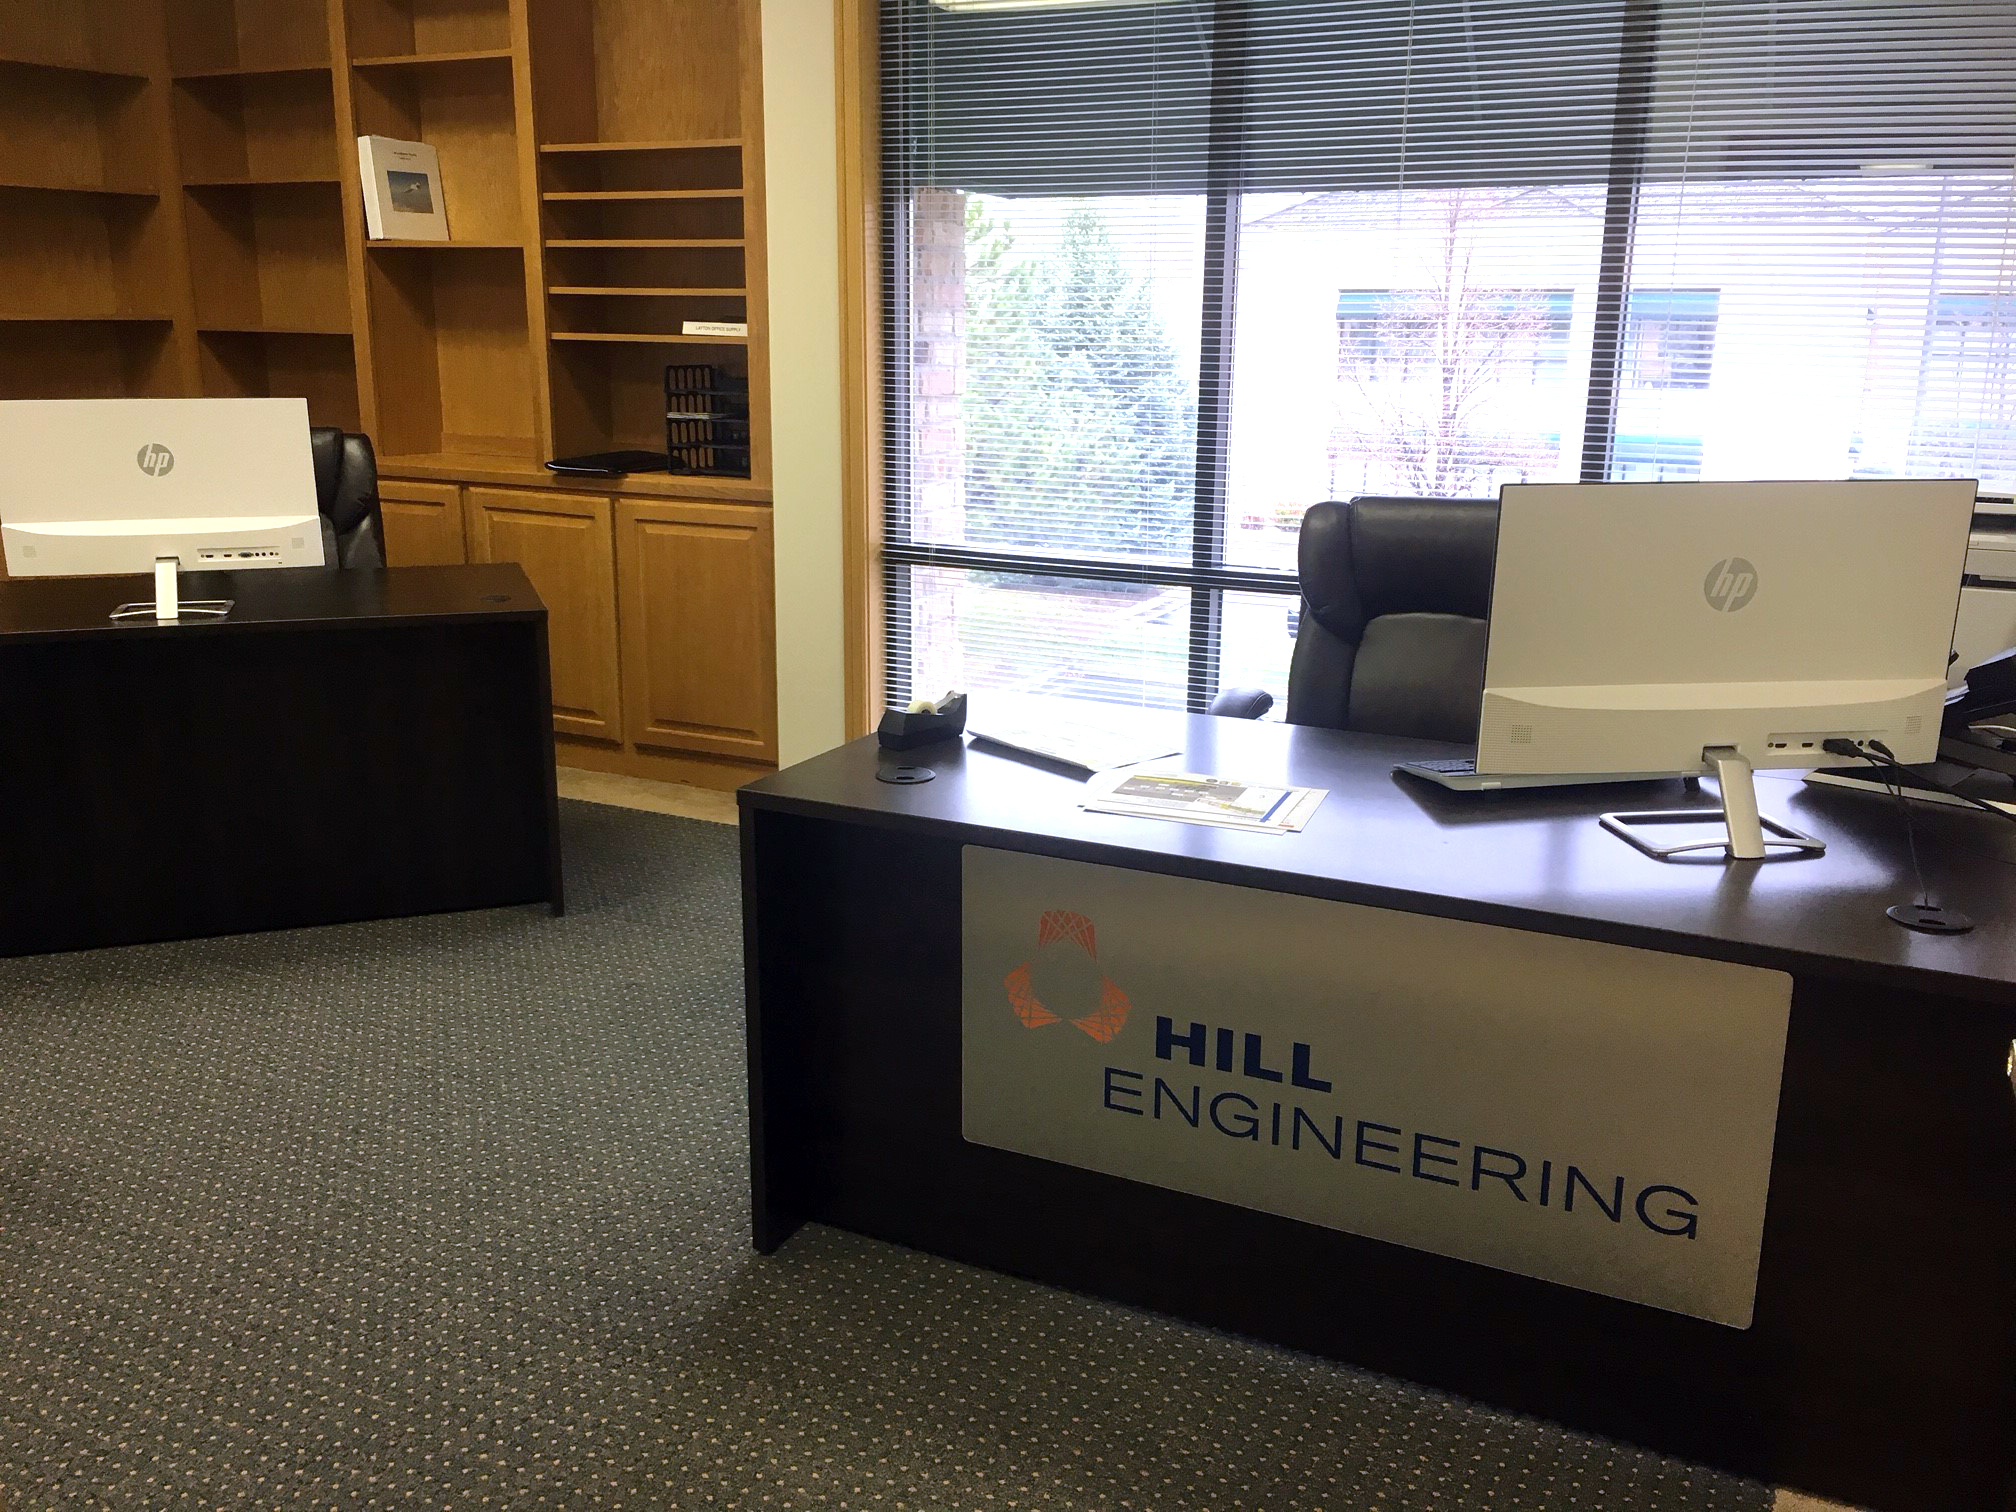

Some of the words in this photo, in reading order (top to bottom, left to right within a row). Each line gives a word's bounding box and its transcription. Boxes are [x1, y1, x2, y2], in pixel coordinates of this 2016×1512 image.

[141, 443, 171, 477] hp
[1709, 557, 1754, 612] hp
[1155, 1015, 1333, 1094] HILL
[1103, 1066, 1699, 1241] ENGINEERING
